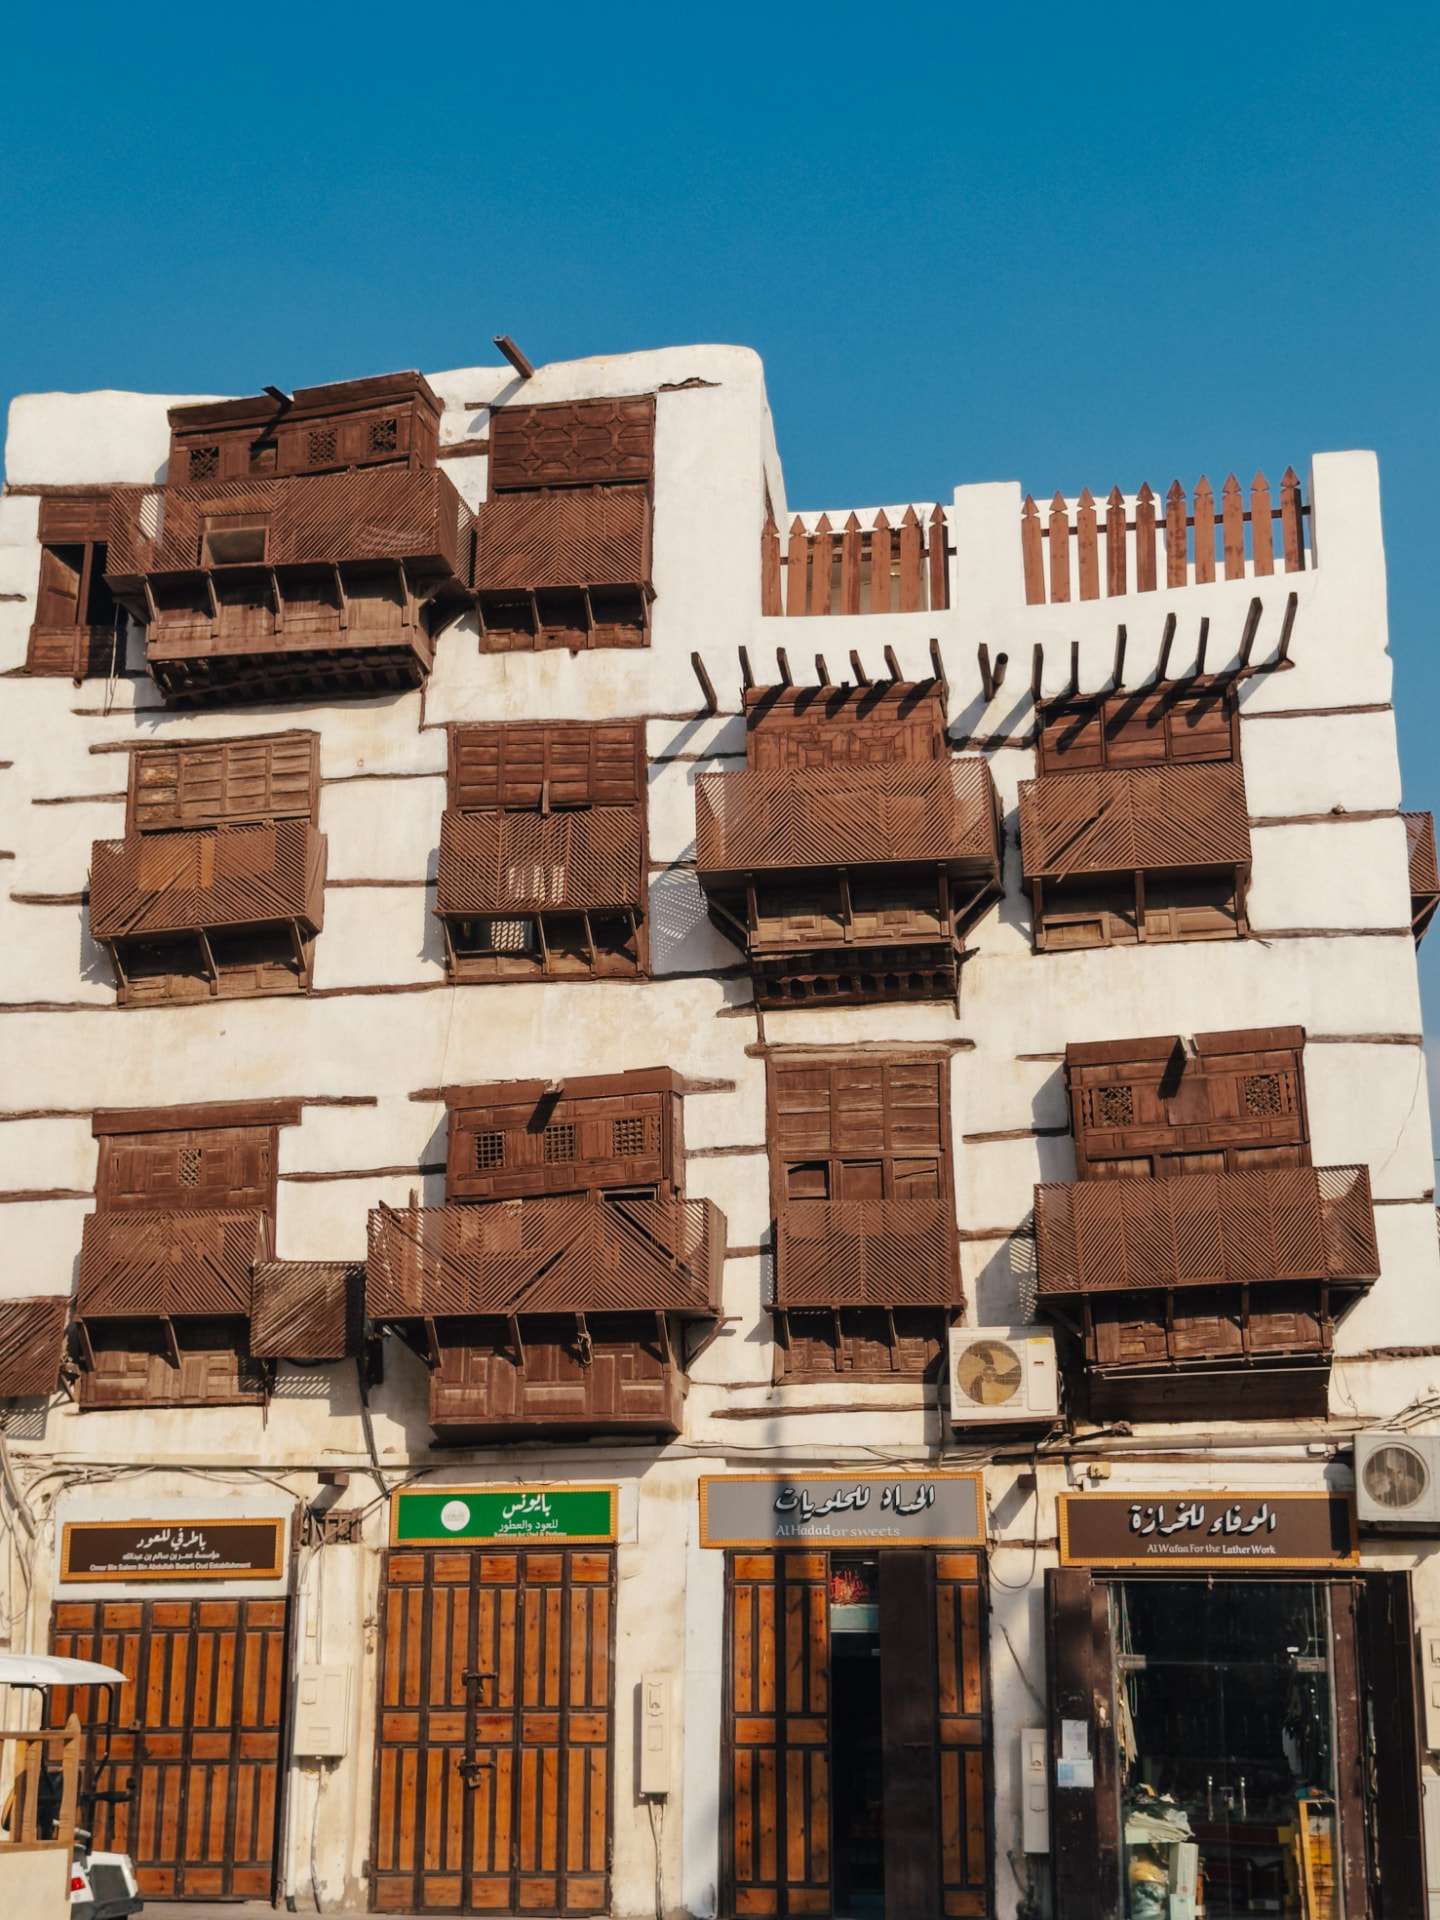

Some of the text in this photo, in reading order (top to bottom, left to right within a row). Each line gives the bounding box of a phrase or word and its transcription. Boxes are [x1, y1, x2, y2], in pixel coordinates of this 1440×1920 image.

[775, 1484, 935, 1520] الحداد للحلويات
[498, 1519, 559, 1533] للعود والعطور
[1130, 1502, 1276, 1534] الوفاء للخرازة
[136, 1529, 171, 1549] للعود
[775, 1525, 789, 1536] Al
[850, 1526, 900, 1537] sweets
[1147, 1544, 1276, 1554] Al Wafaa For the Lather Work
